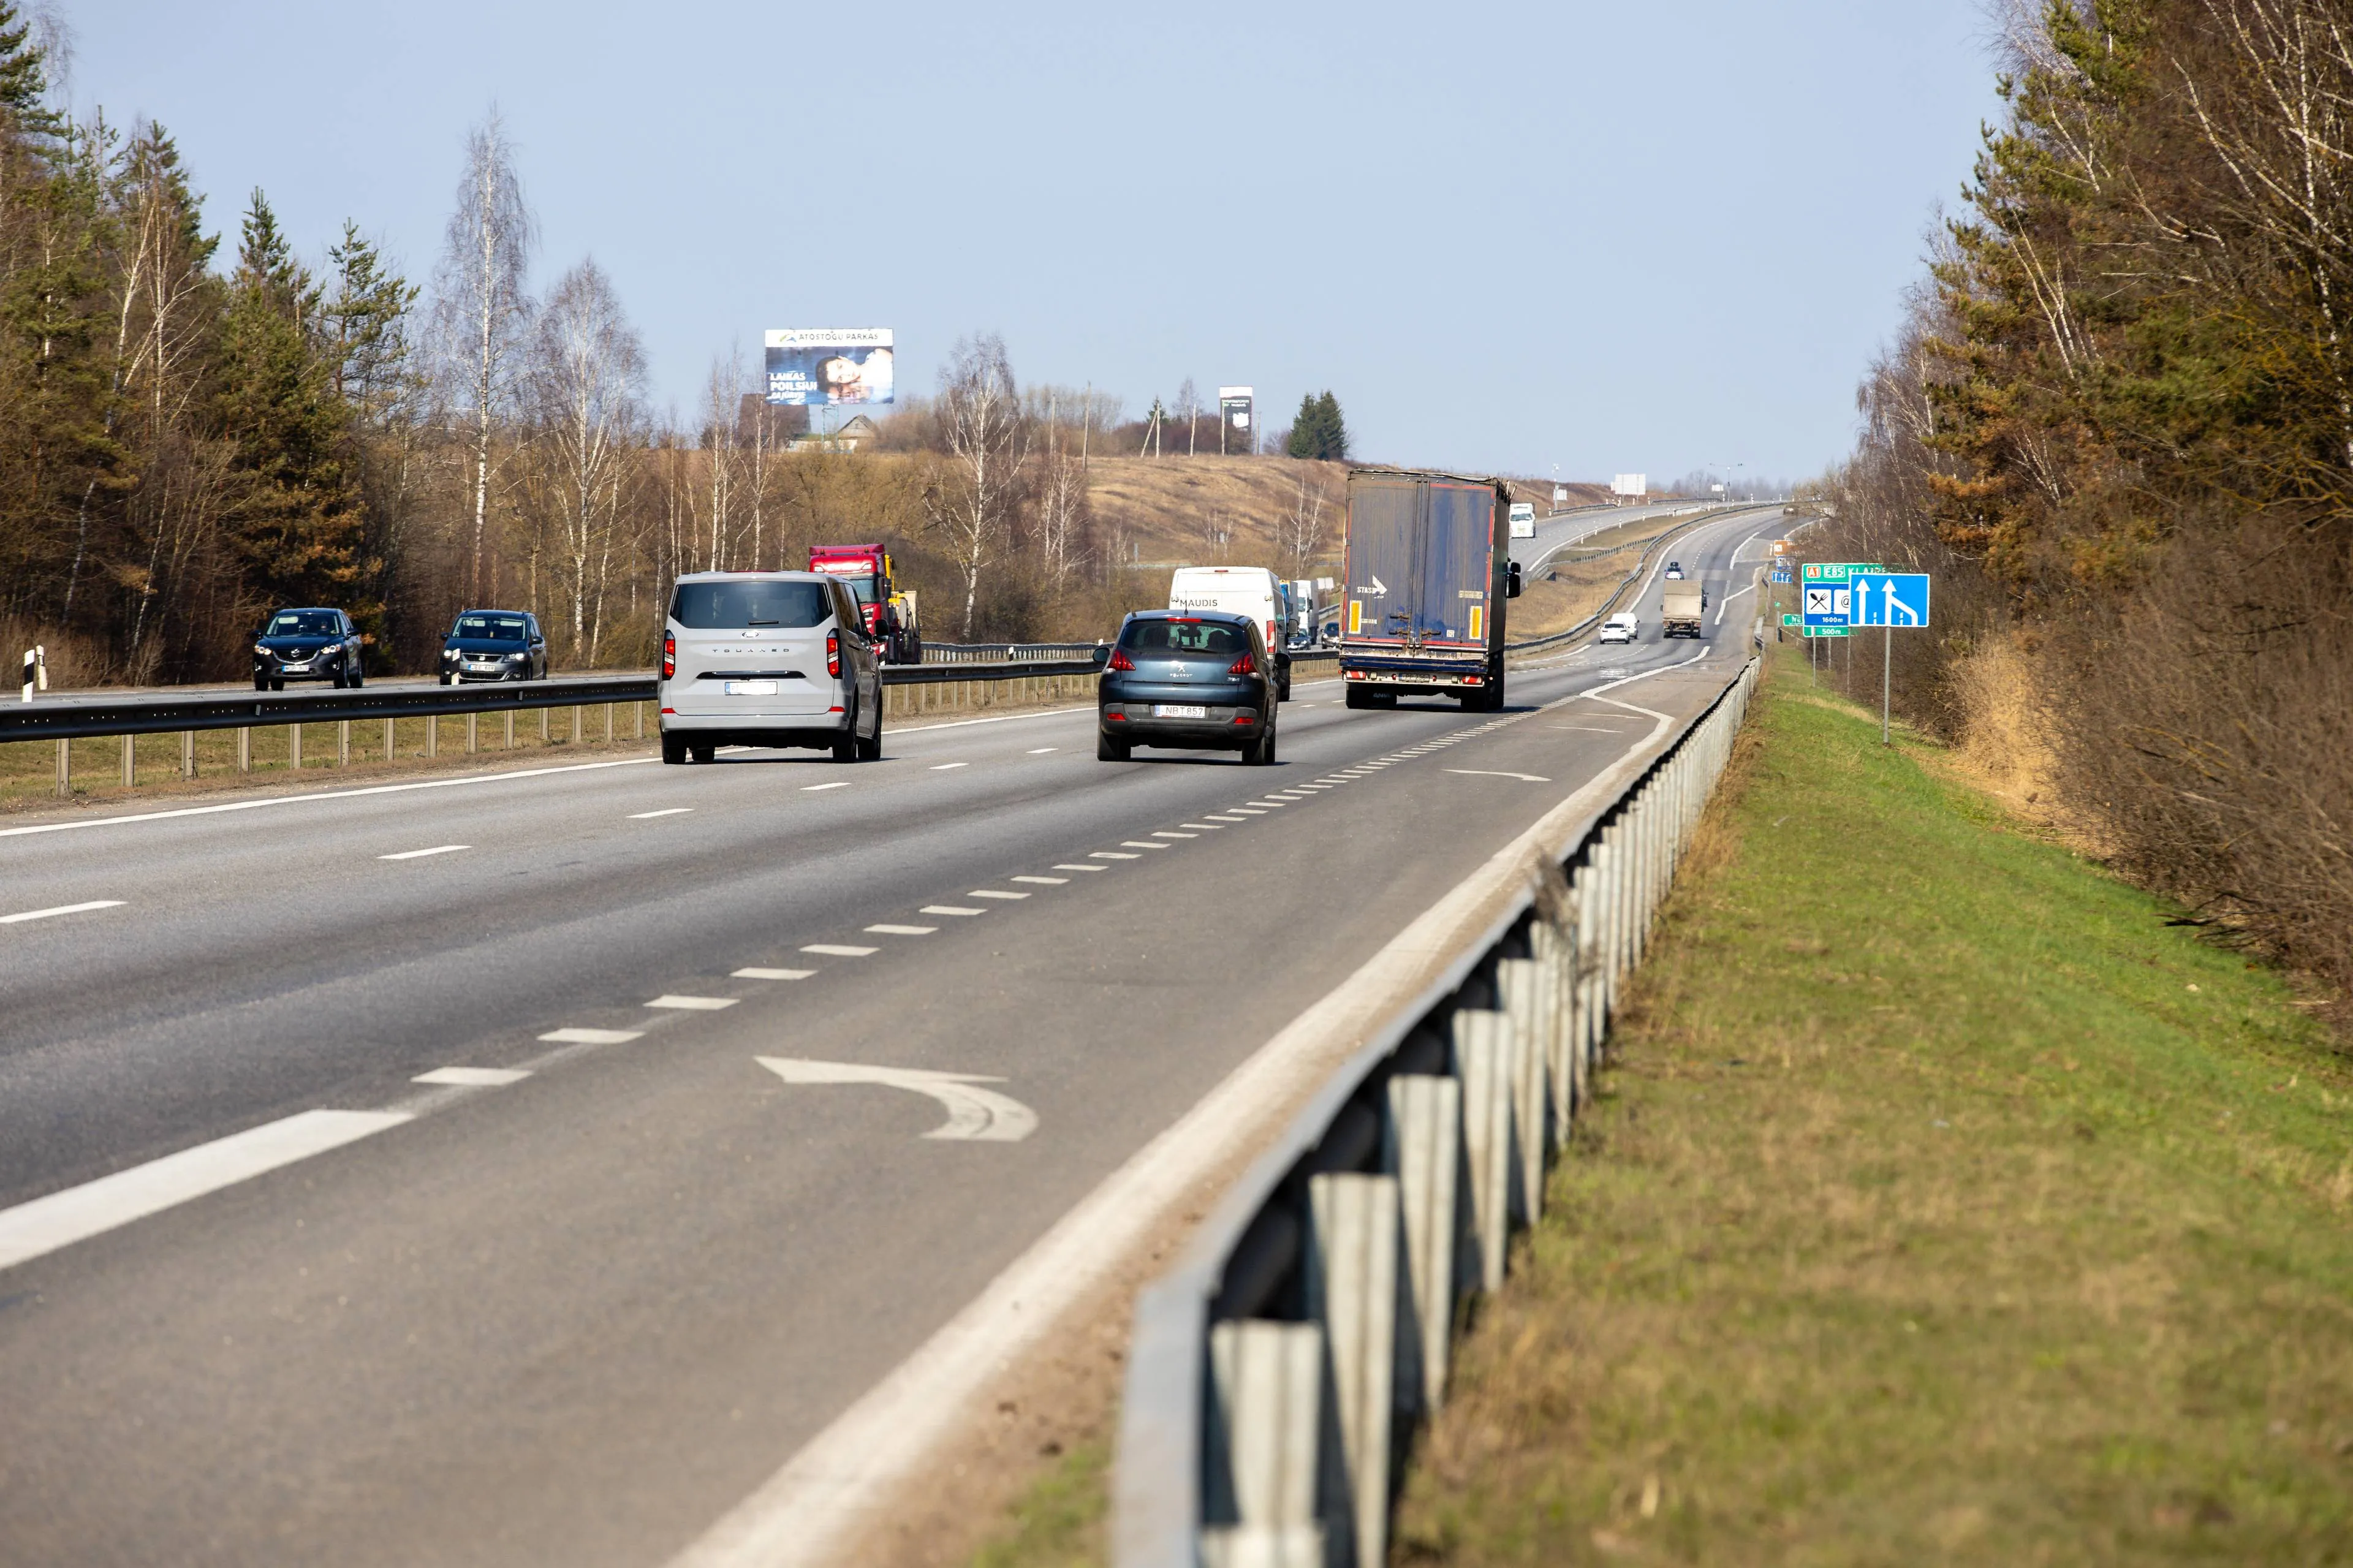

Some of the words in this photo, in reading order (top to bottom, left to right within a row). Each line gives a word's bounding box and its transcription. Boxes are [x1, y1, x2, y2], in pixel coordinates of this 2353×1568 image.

[770, 372, 806, 381] LAIKAS
[770, 381, 817, 391] POILSIUI
[1808, 567, 1819, 577] A1
[1825, 567, 1844, 577] E85
[1165, 706, 1185, 715] NBT
[1186, 707, 1203, 716] 857
